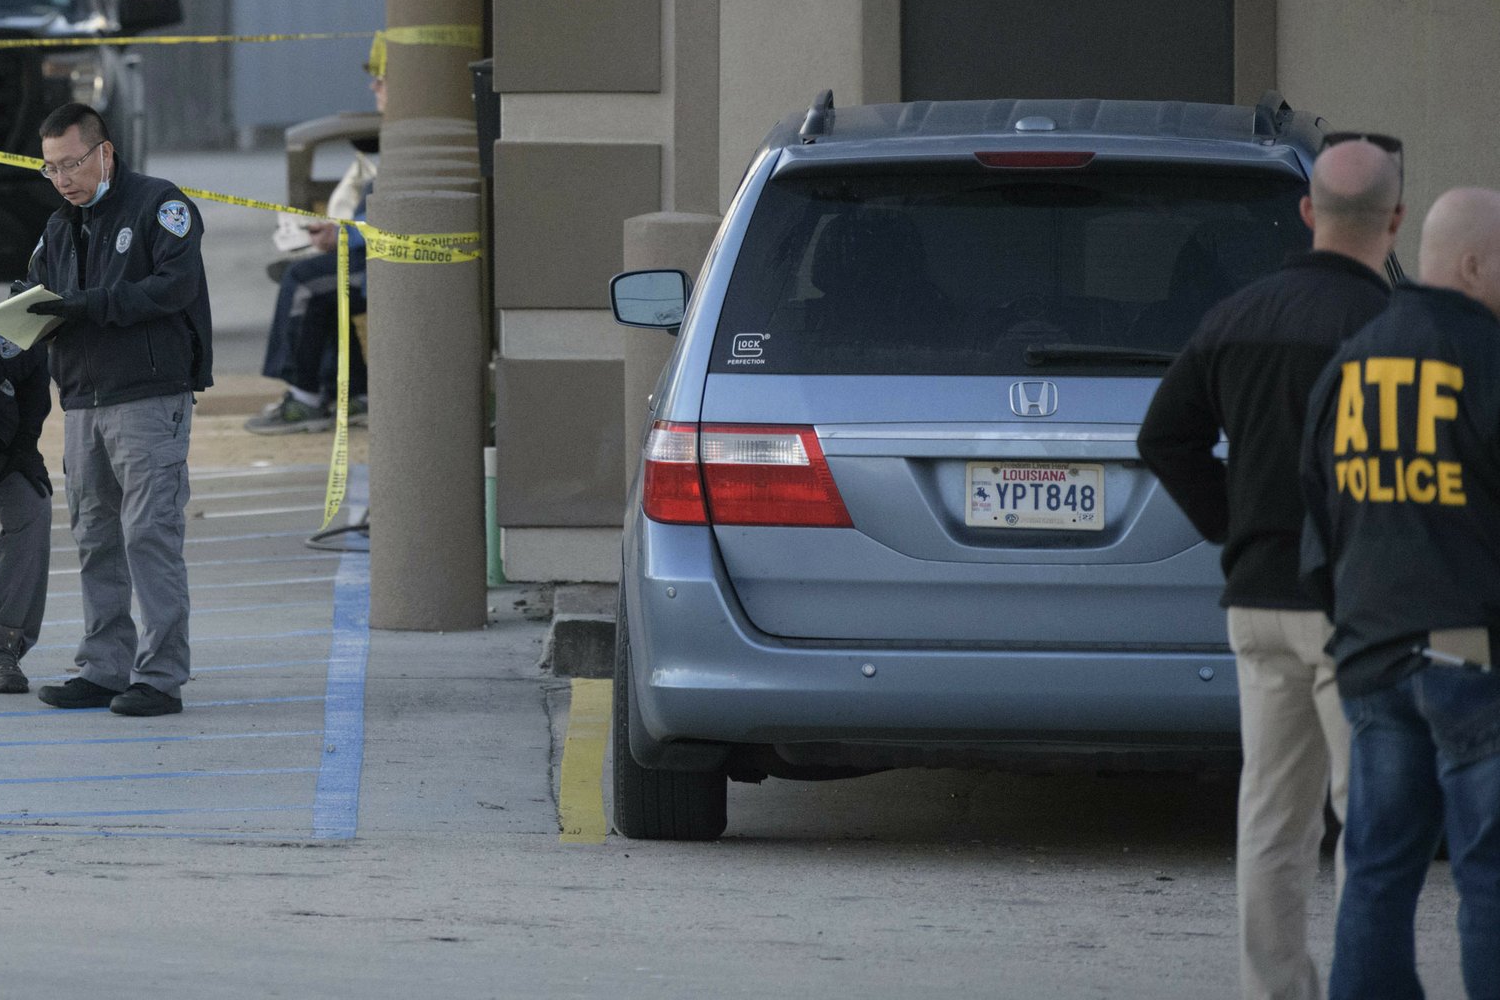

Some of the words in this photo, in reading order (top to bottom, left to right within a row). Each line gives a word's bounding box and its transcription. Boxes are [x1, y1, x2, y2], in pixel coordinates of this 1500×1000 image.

[1334, 357, 1464, 456] ATF
[1003, 470, 1067, 481] LOUISIANA
[996, 483, 1095, 511] YPT848
